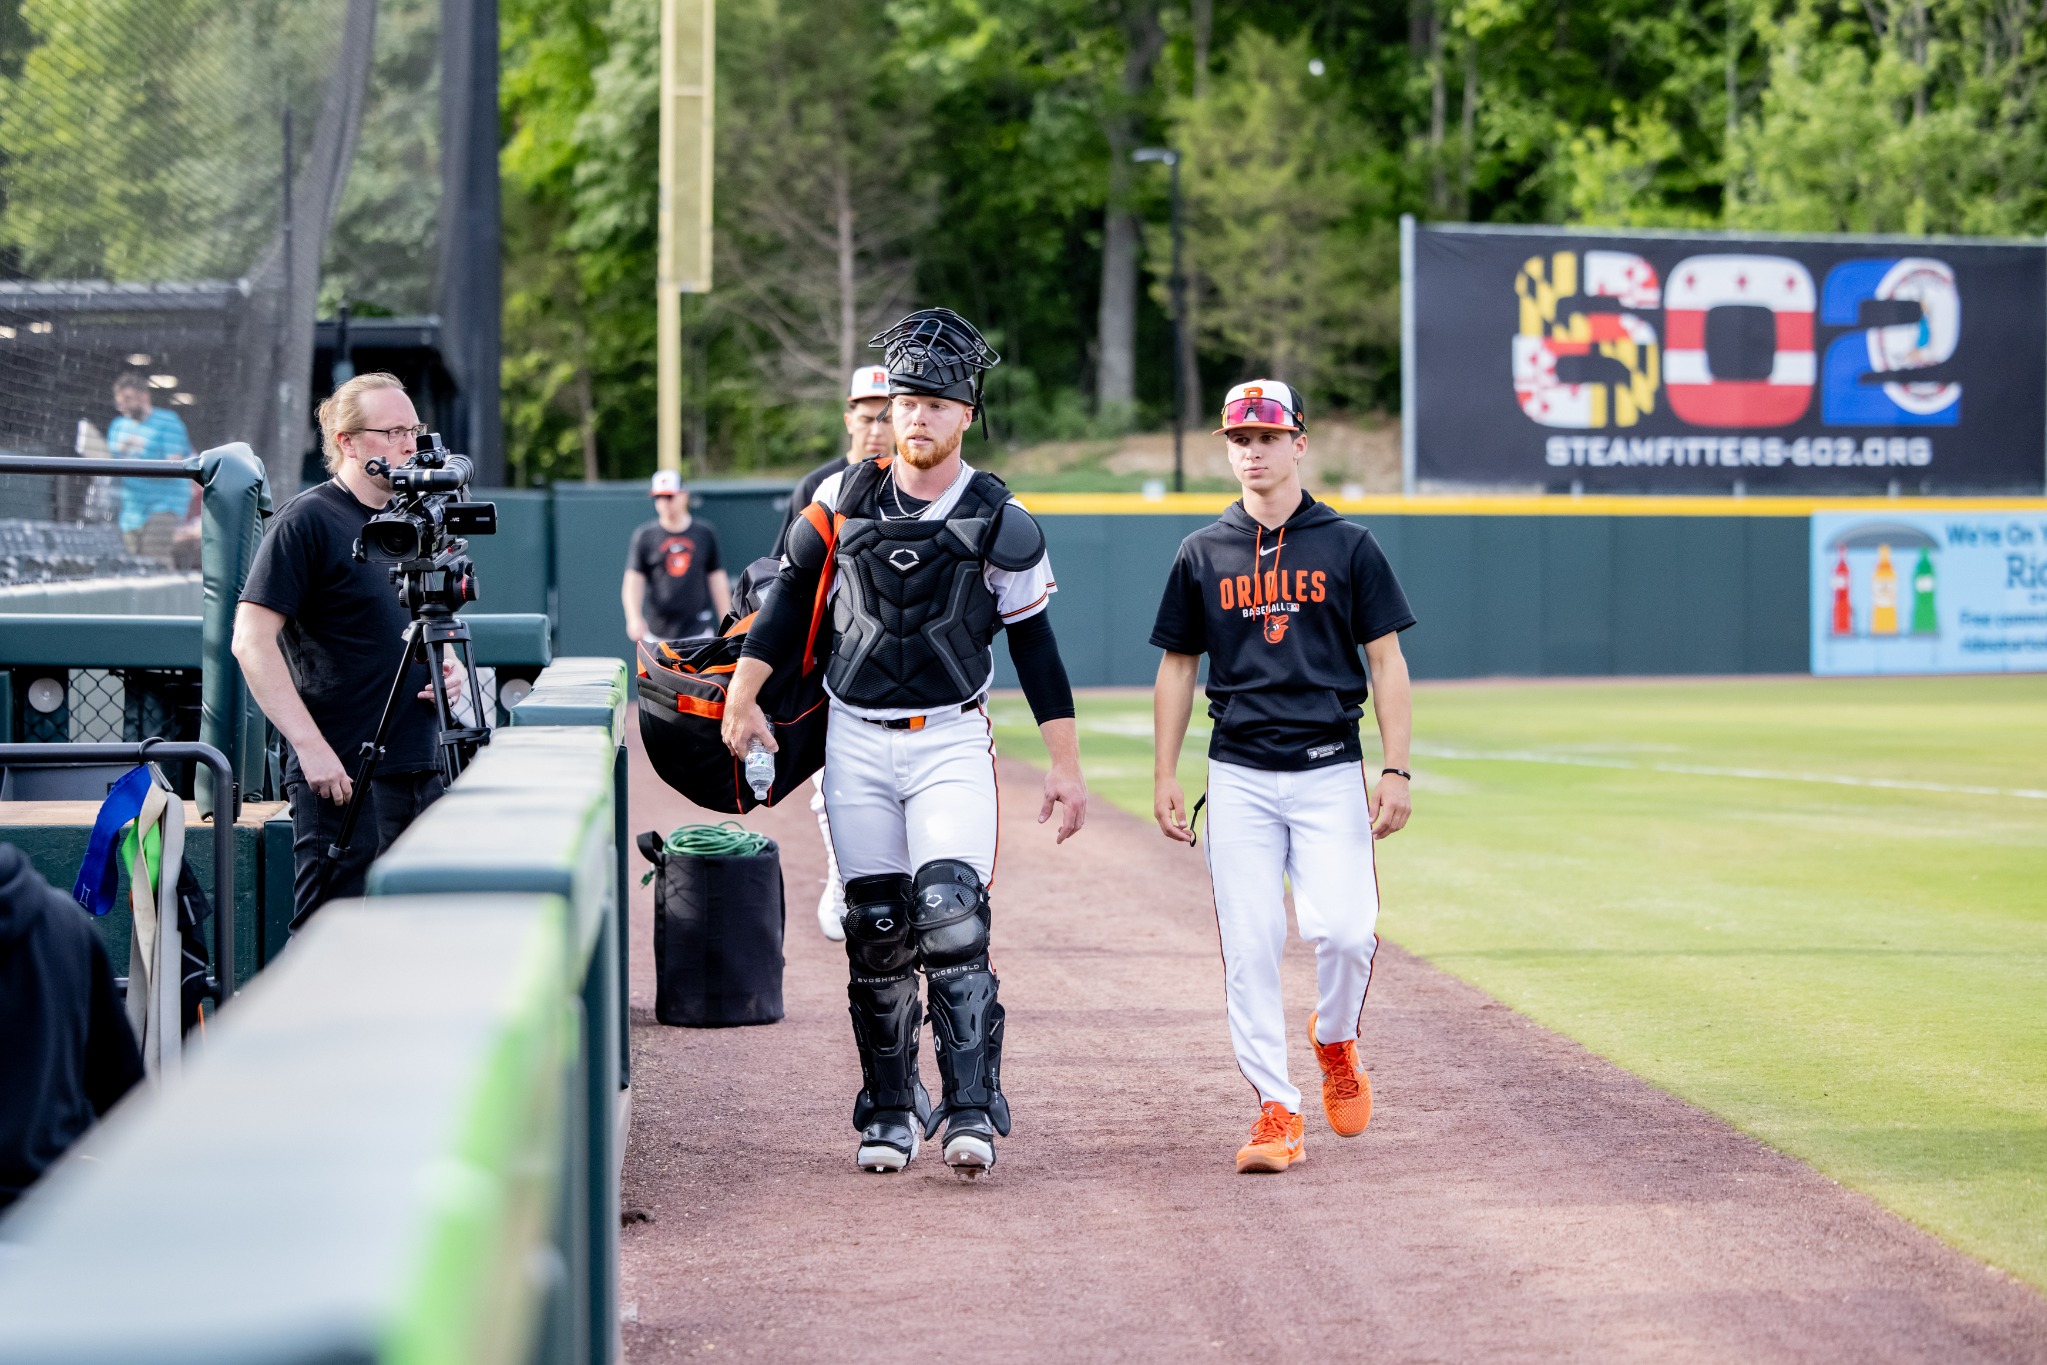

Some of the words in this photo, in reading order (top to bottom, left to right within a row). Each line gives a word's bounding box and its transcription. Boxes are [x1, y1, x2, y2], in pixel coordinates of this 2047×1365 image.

[1512, 250, 1961, 430] 602
[1545, 436, 1933, 468] STEAMFITTERS-602.ORG
[1219, 569, 1327, 611] ORIOLES
